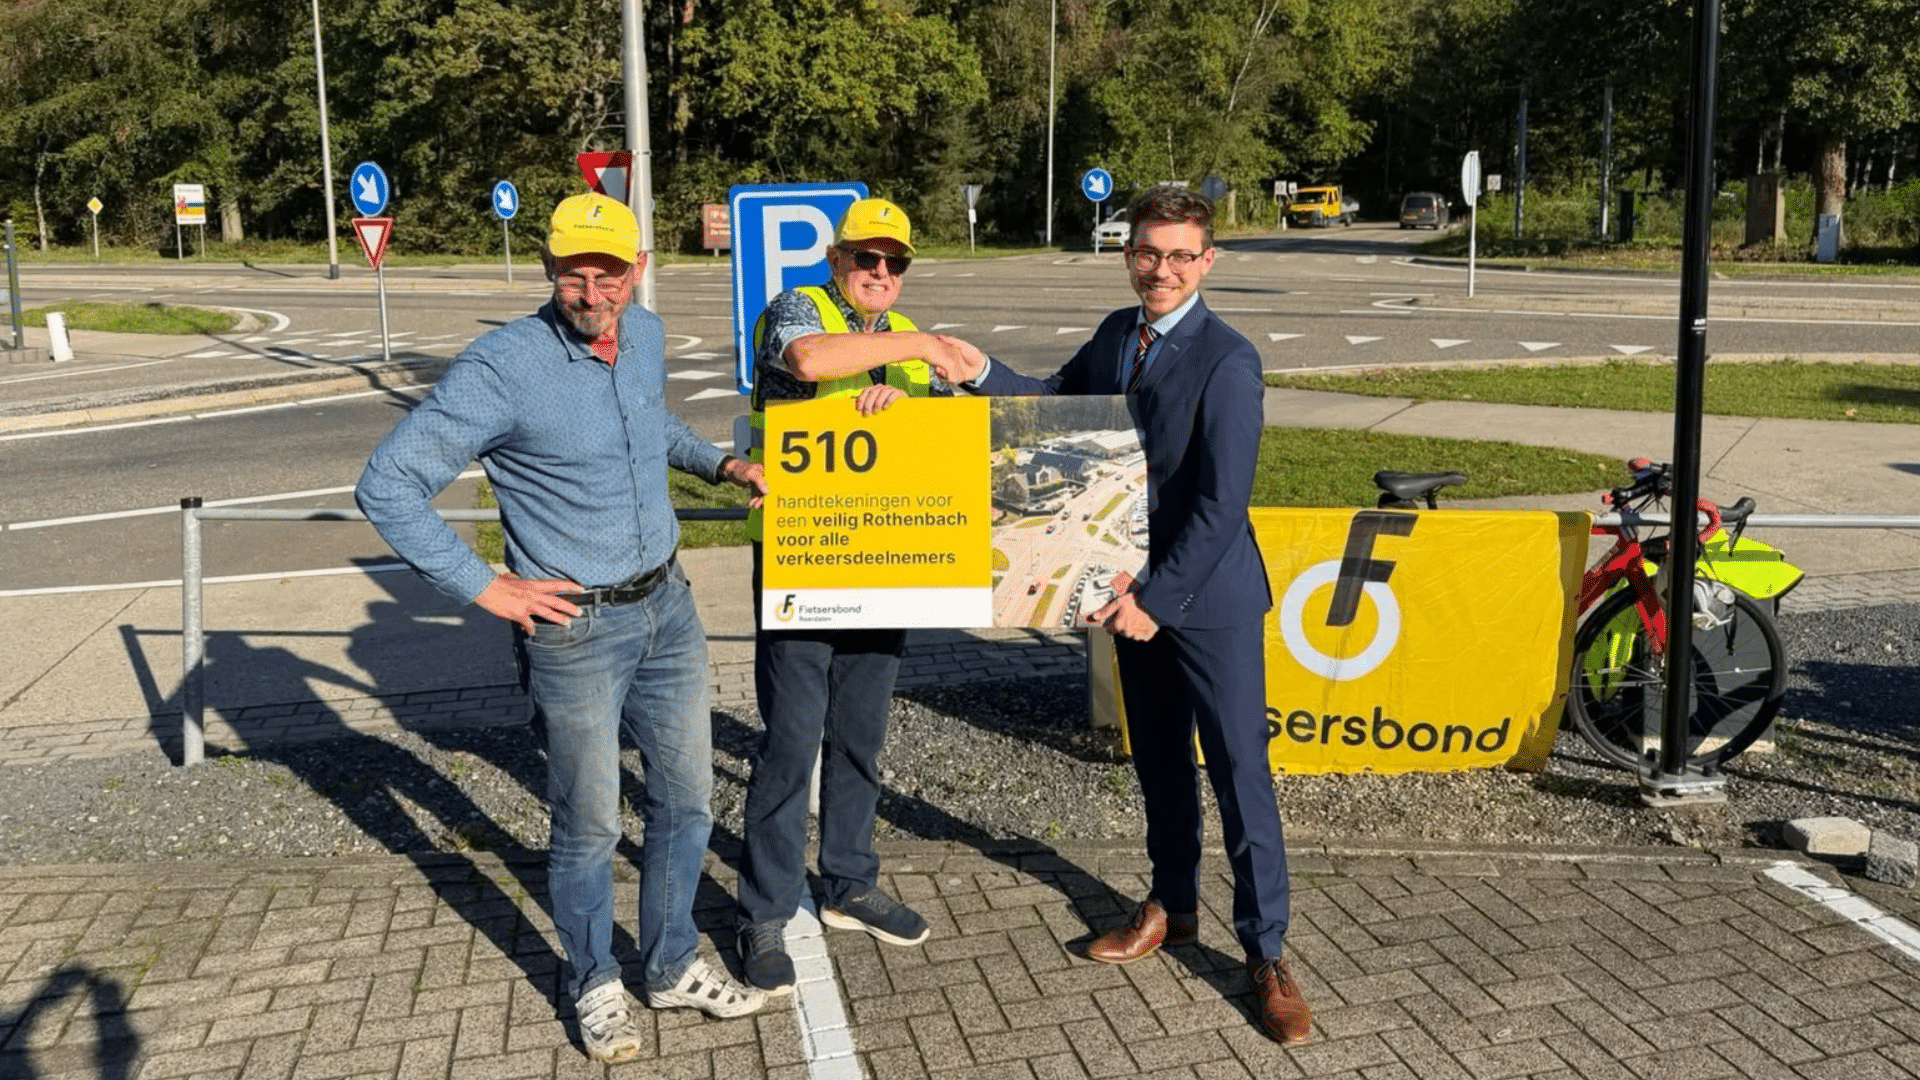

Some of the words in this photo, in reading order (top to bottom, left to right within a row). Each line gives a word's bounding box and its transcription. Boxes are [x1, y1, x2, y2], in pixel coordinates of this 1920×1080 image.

[762, 205, 835, 306] P
[780, 429, 878, 473] 510
[777, 493, 911, 511] handtekeningen
[916, 494, 953, 507] voor
[776, 514, 807, 527] een
[812, 512, 858, 530] veilig
[863, 512, 967, 526] Rothenbach
[776, 533, 815, 546] voor
[819, 531, 850, 546] alle
[776, 551, 956, 566] verkeersdeelnemers
[798, 603, 862, 615] Fietsersbond
[1265, 706, 1511, 753] sersbond
